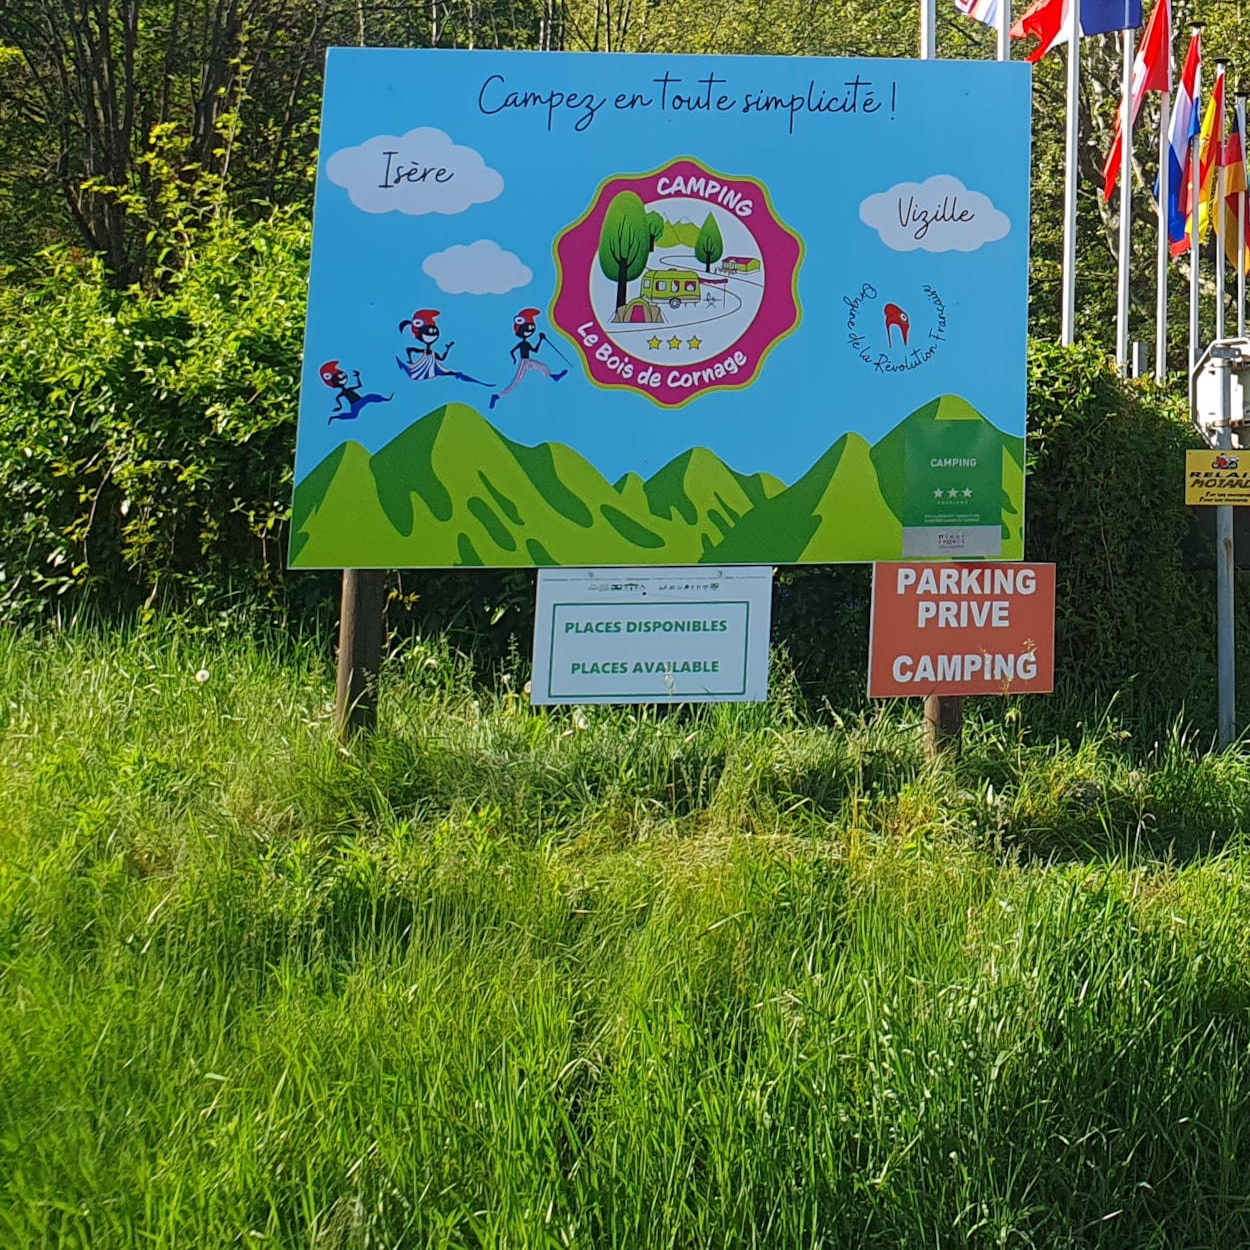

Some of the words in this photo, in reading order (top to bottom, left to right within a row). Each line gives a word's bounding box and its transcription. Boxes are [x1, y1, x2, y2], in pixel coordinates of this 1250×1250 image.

[478, 74, 606, 131] Campez
[614, 92, 653, 110] en
[653, 71, 736, 111] toute
[742, 73, 882, 134] simplicité
[378, 151, 454, 188] Isère
[656, 175, 753, 217] CAMPING
[898, 195, 975, 240] Vizille
[843, 283, 877, 330] Origine
[576, 321, 599, 347] Le
[595, 343, 634, 379] Bois
[637, 366, 662, 388] de
[666, 350, 748, 388] Cornage
[848, 333, 865, 350] de
[859, 345, 872, 362] la
[873, 344, 938, 374] Révolution
[930, 458, 977, 467] CAMPING
[896, 567, 1037, 596] PARKING
[564, 621, 621, 634] PLACES
[626, 620, 728, 633] DISPONIBLES
[917, 600, 1010, 628] PRIVE
[571, 661, 628, 674] PLACES
[632, 661, 719, 673] AVAILABLE
[892, 653, 1038, 683] CAMPING
